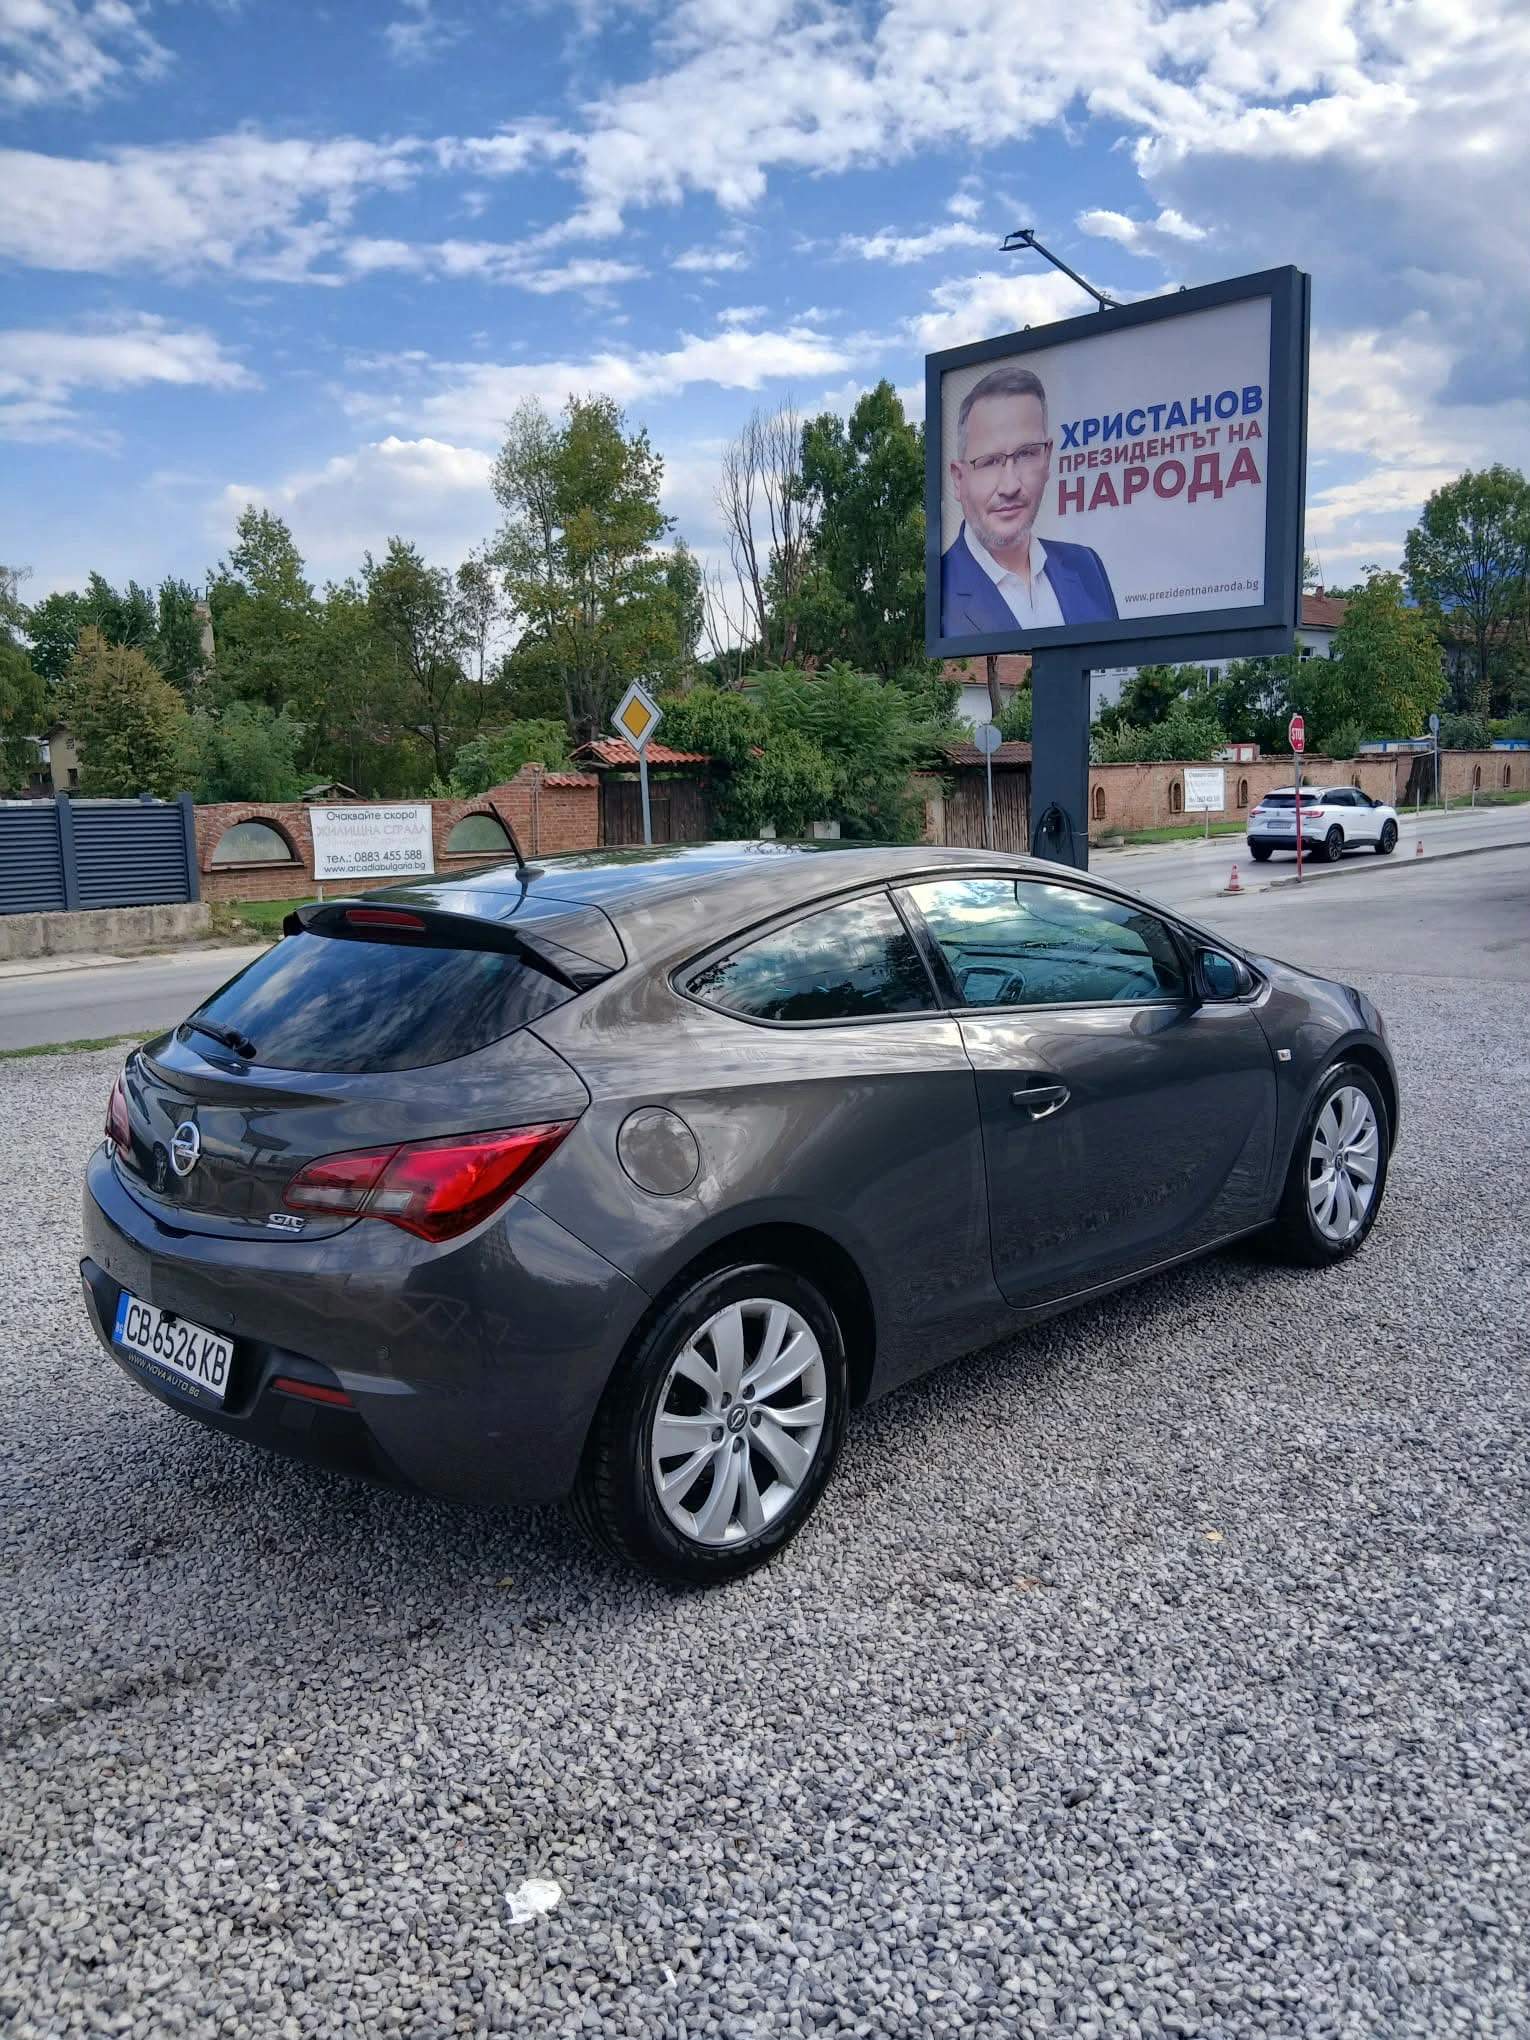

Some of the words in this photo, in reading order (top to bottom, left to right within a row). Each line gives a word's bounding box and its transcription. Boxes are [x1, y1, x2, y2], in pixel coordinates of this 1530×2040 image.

[1060, 385, 1263, 450] ХРИСТАНОВ
[1059, 427, 1221, 474] ПРЕЗИДЕНТЪТ
[1228, 420, 1262, 443] НА
[1058, 447, 1261, 516] НАРОДА
[1125, 579, 1259, 603] www.prezidentnanaroda.bg
[326, 811, 381, 821] Очаквайте
[383, 810, 417, 821] скоро!
[326, 854, 352, 863] тел.:
[354, 851, 380, 863] 0883
[383, 850, 402, 861] 455
[404, 849, 423, 860] 588
